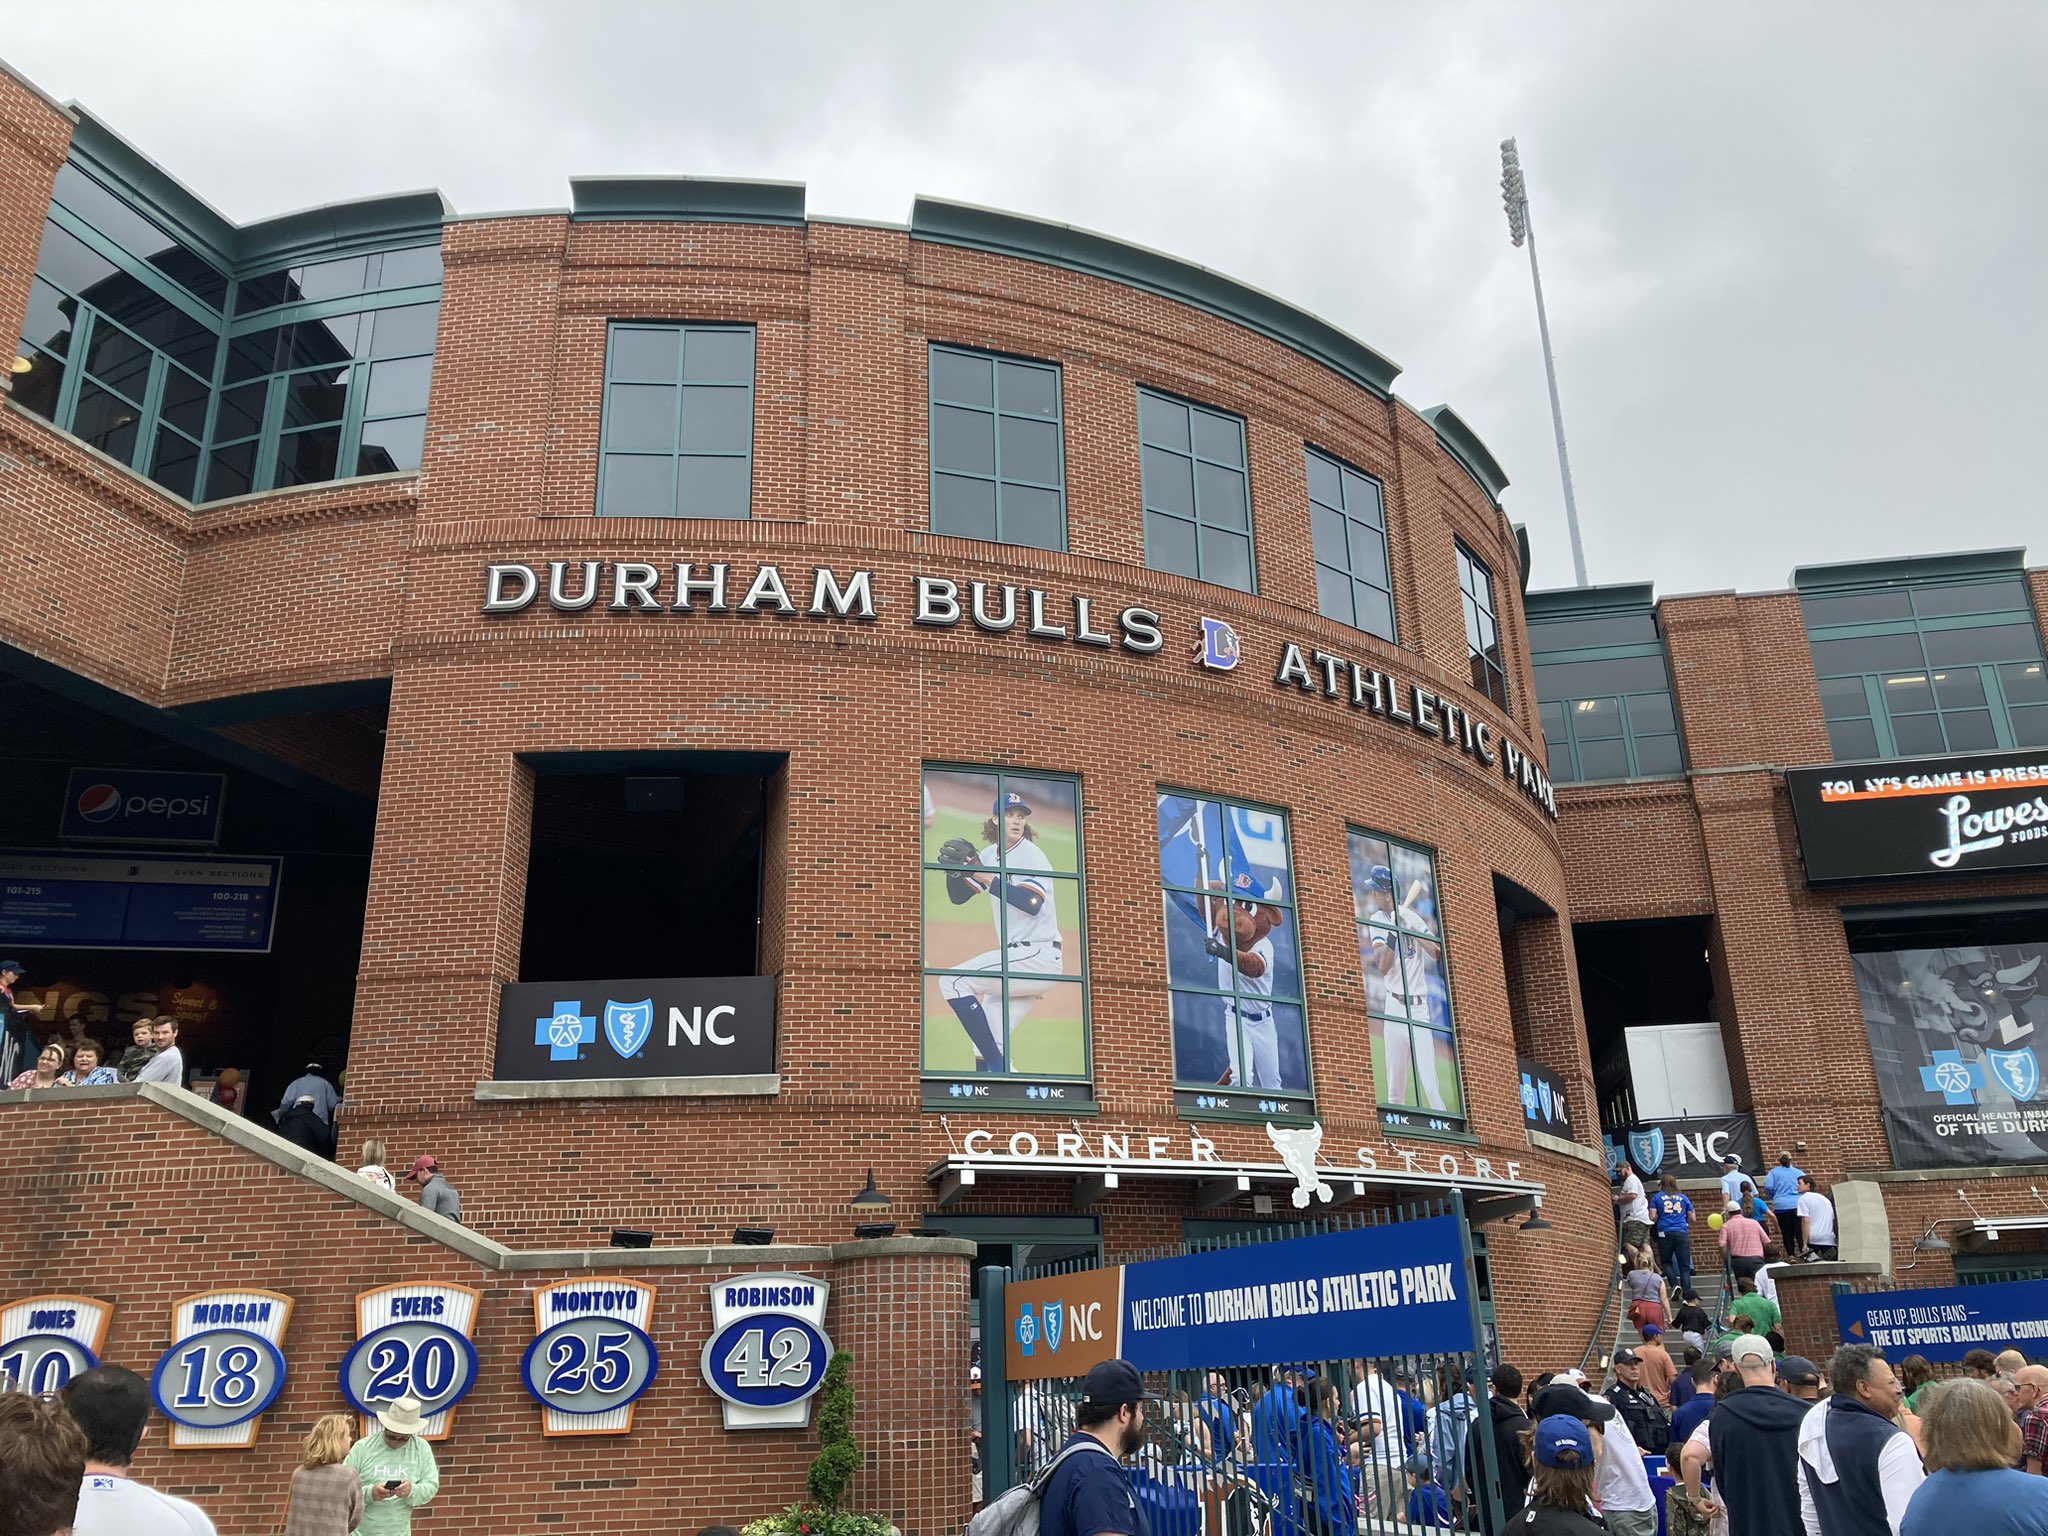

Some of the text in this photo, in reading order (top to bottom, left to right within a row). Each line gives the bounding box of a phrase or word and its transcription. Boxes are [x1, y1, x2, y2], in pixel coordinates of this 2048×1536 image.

[483, 561, 1163, 653] DURHAM BULLS
[1277, 642, 1559, 822] ATHLETIC PARK
[1905, 771, 1961, 789] GAME
[1969, 769, 1987, 784] IS
[124, 796, 209, 819] pepsi
[1930, 795, 2048, 867] Lowes
[2010, 825, 2048, 843] FOODS
[174, 869, 264, 880] EVEN SECTIONS
[6, 886, 41, 896] 101-215
[213, 892, 249, 902] 100-218
[172, 992, 205, 1008] Sweet
[667, 1005, 736, 1046] NC
[975, 1086, 990, 1096] NC
[1050, 1088, 1065, 1098] NC
[1217, 1099, 1230, 1109] NC
[1278, 1102, 1290, 1113] NC
[1400, 1115, 1410, 1125] NC
[1442, 1121, 1452, 1131] NC
[1933, 1113, 1980, 1123] OFFICIAL
[1982, 1110, 2022, 1120] HEALTH
[1935, 1123, 1960, 1136] OF
[1962, 1121, 1999, 1135] THE
[963, 1130, 1217, 1161] CORNER
[1675, 1131, 1729, 1164] NC
[1663, 1200, 1682, 1213] 24
[390, 1296, 444, 1317] EVERS
[551, 1290, 638, 1312] MONTOYO
[725, 1286, 815, 1307] ROBINSON
[1131, 1263, 1456, 1331] WELCOME TO DURHAM BULLS ATHLETIC PARK
[27, 1310, 76, 1330] JONES
[192, 1303, 271, 1324] MORGAN
[1069, 1302, 1102, 1342] NC
[1866, 1310, 1891, 1327] GEAR
[1910, 1306, 1940, 1324] BULLS
[1941, 1304, 1967, 1322] FANS
[1870, 1330, 1892, 1347] THE
[1892, 1329, 1906, 1346] OT
[1907, 1326, 1952, 1345] SPORTS
[1952, 1322, 2011, 1343] BALLPARK
[545, 1331, 633, 1395] 25
[724, 1327, 811, 1387] 42
[0, 1348, 75, 1398] 10
[173, 1344, 261, 1408] 18
[364, 1335, 459, 1401] 20
[373, 1465, 408, 1477] Huk
